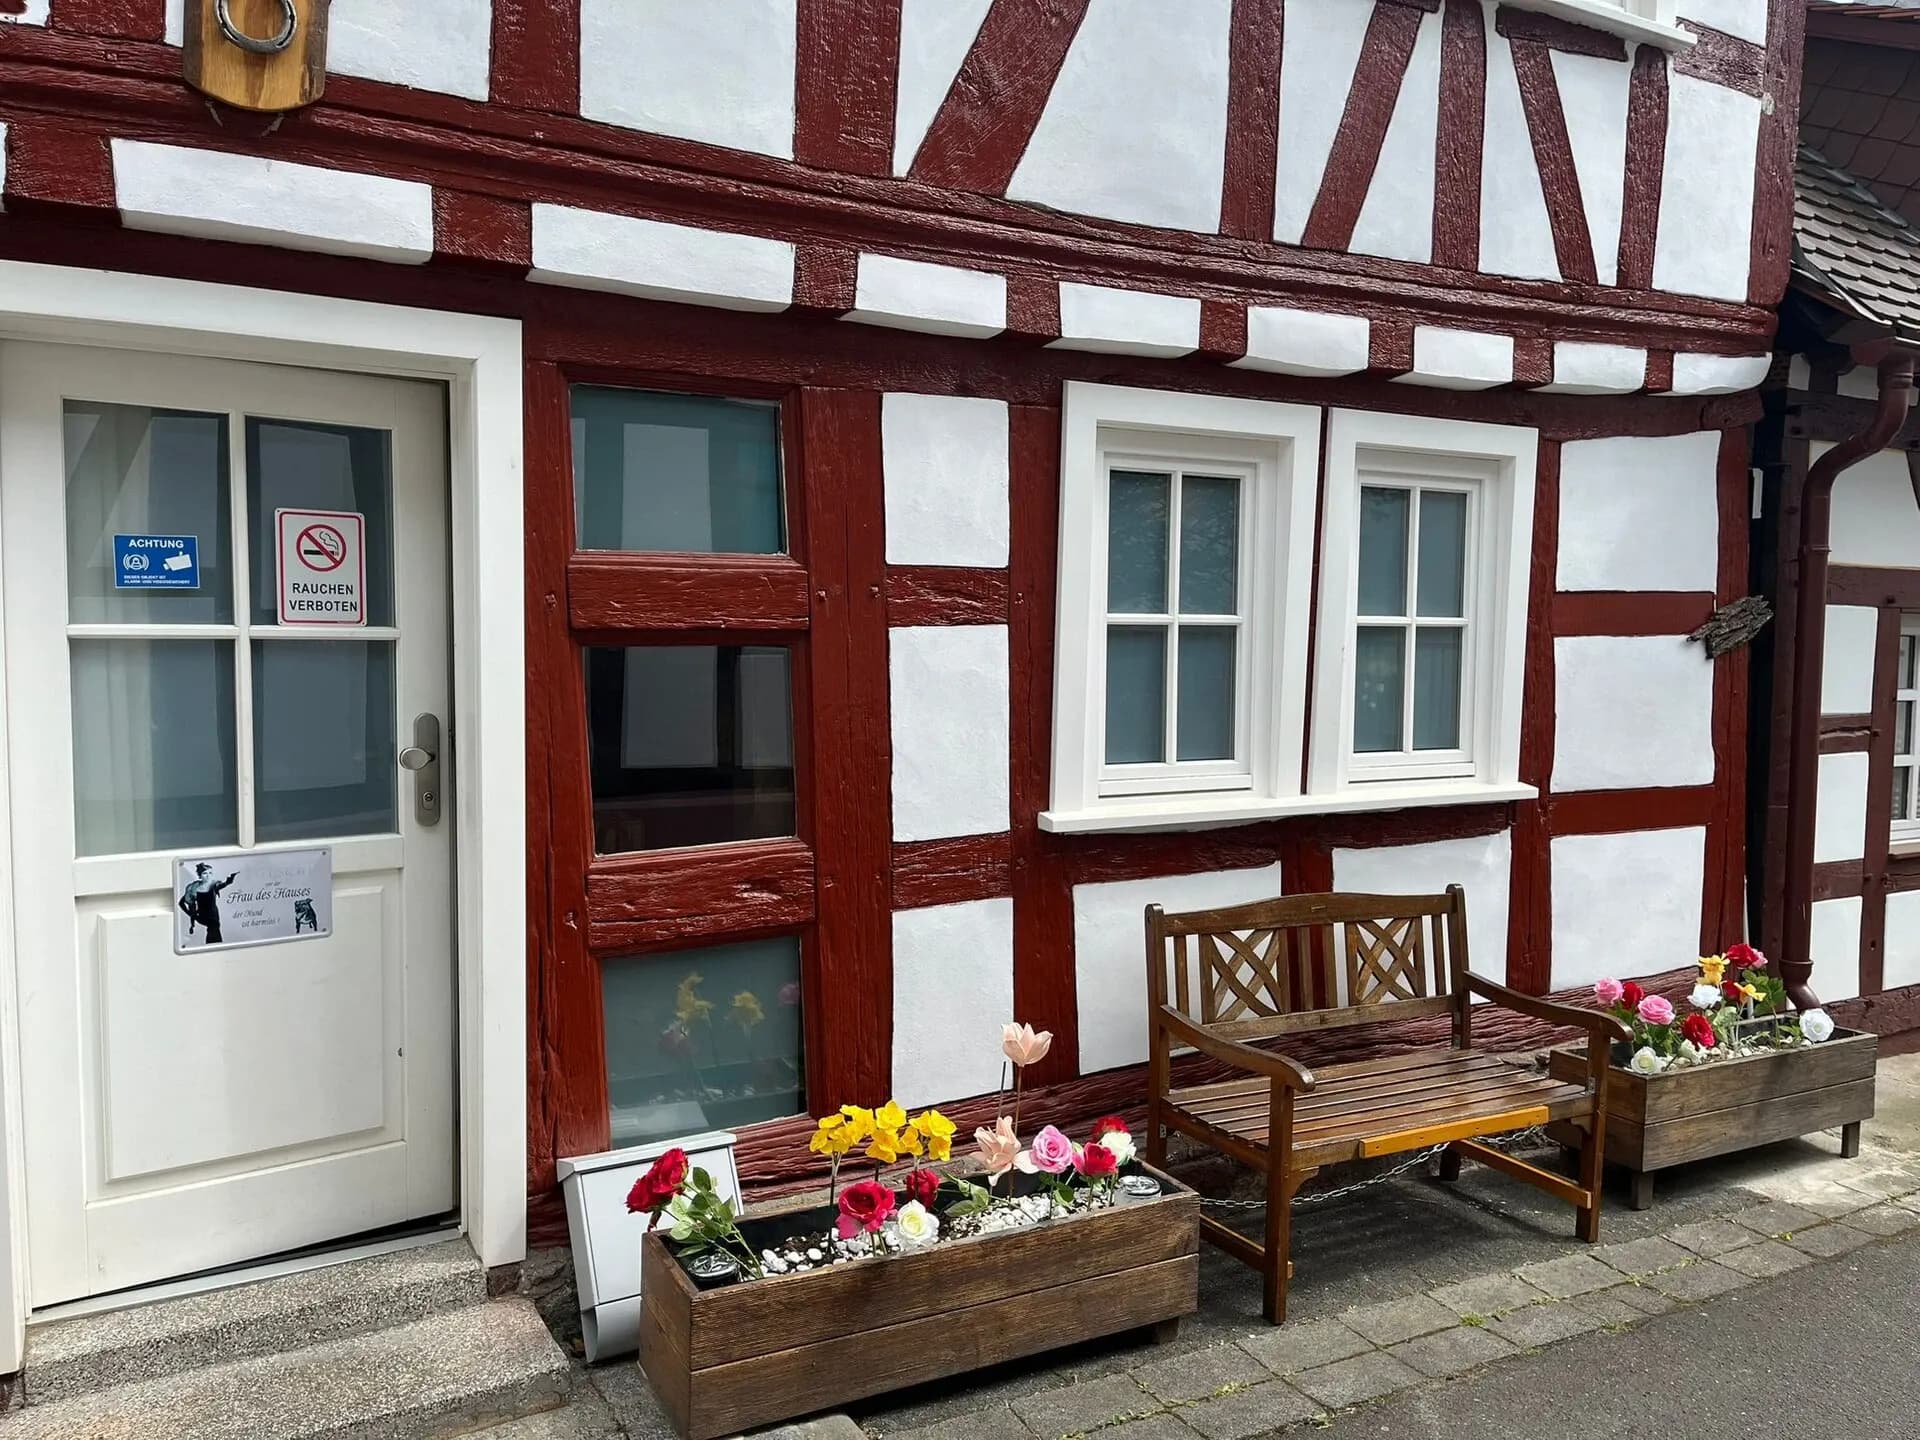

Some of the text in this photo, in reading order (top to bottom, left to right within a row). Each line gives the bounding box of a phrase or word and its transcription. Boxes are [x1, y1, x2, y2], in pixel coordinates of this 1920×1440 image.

[129, 539, 184, 548] ACHTUNG
[292, 583, 353, 595] RAUCHEN
[289, 600, 358, 612] VERBOTEN
[226, 887, 311, 904] Frau des Hauses
